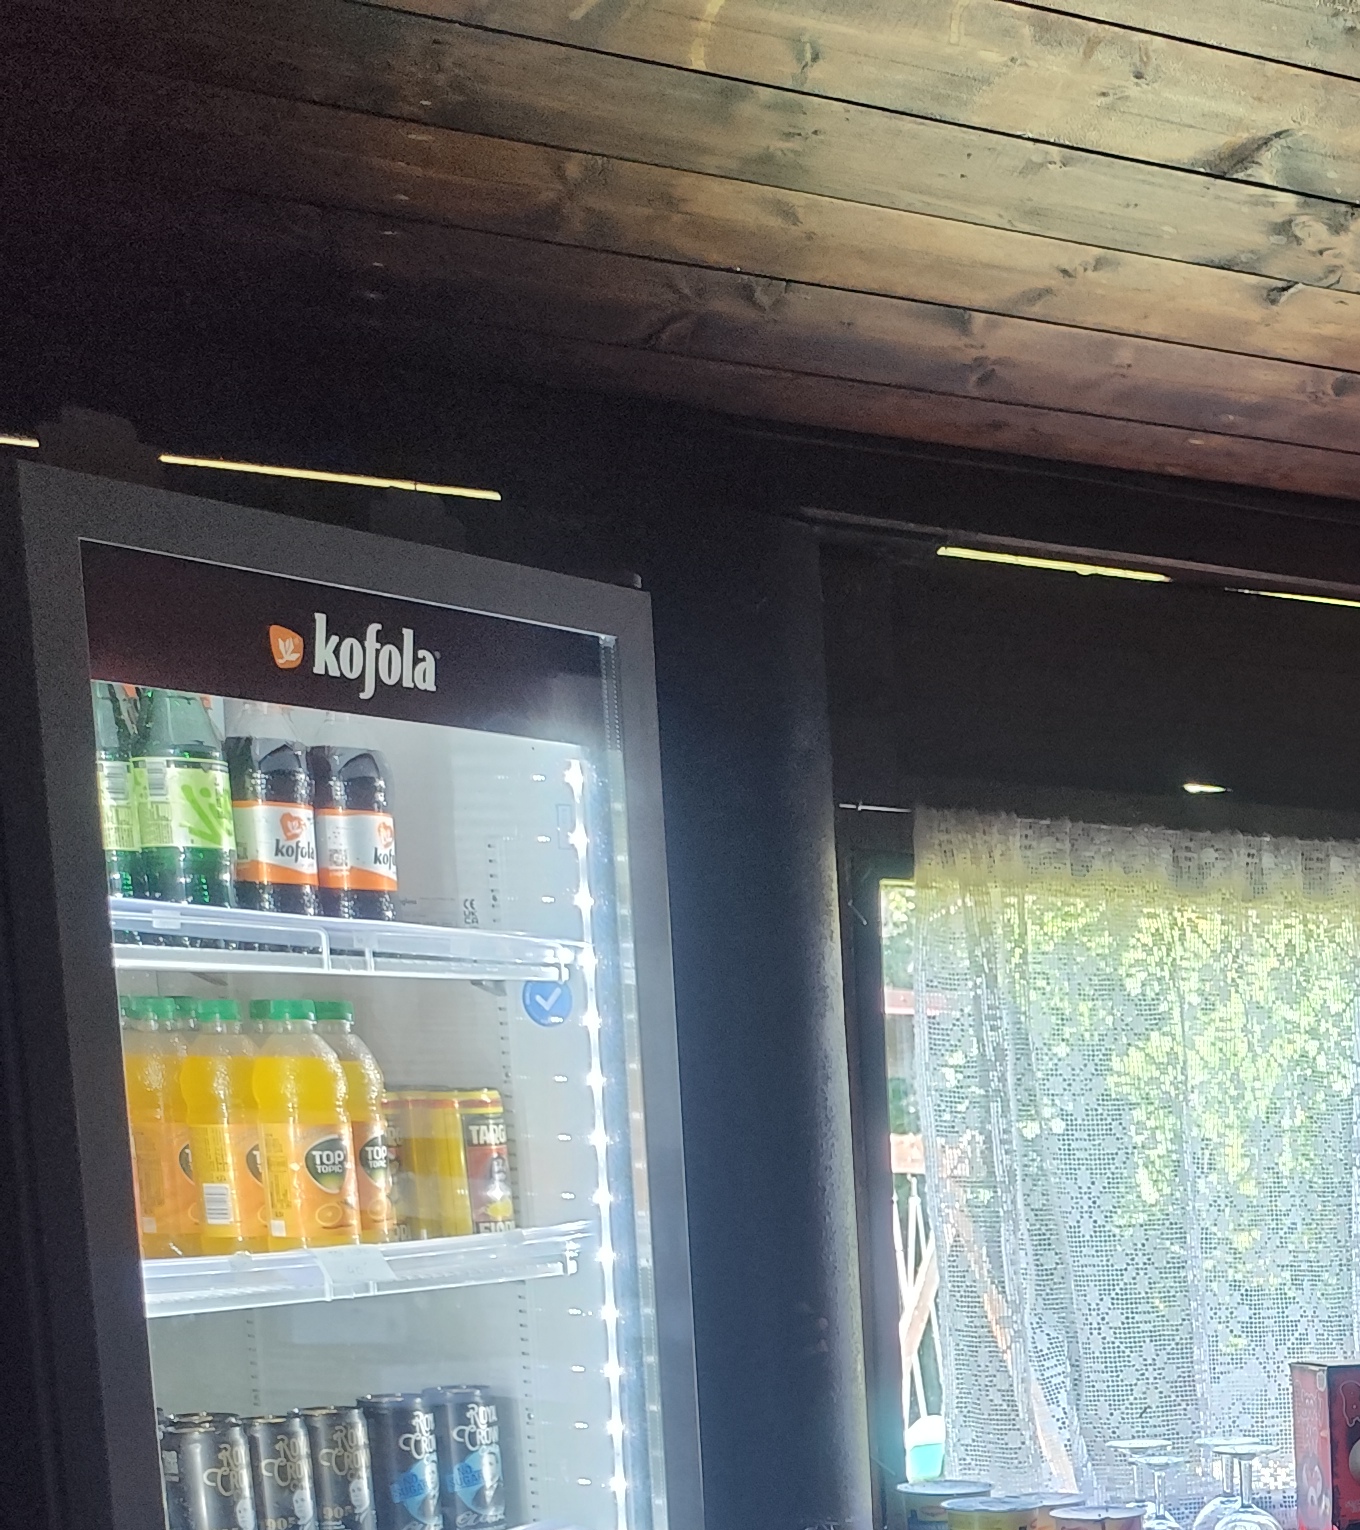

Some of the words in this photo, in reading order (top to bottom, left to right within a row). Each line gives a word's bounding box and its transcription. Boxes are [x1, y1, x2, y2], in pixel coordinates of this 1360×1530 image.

[313, 612, 437, 700] kofola
[312, 1150, 345, 1166] TOP
[364, 1146, 388, 1160] TOP
